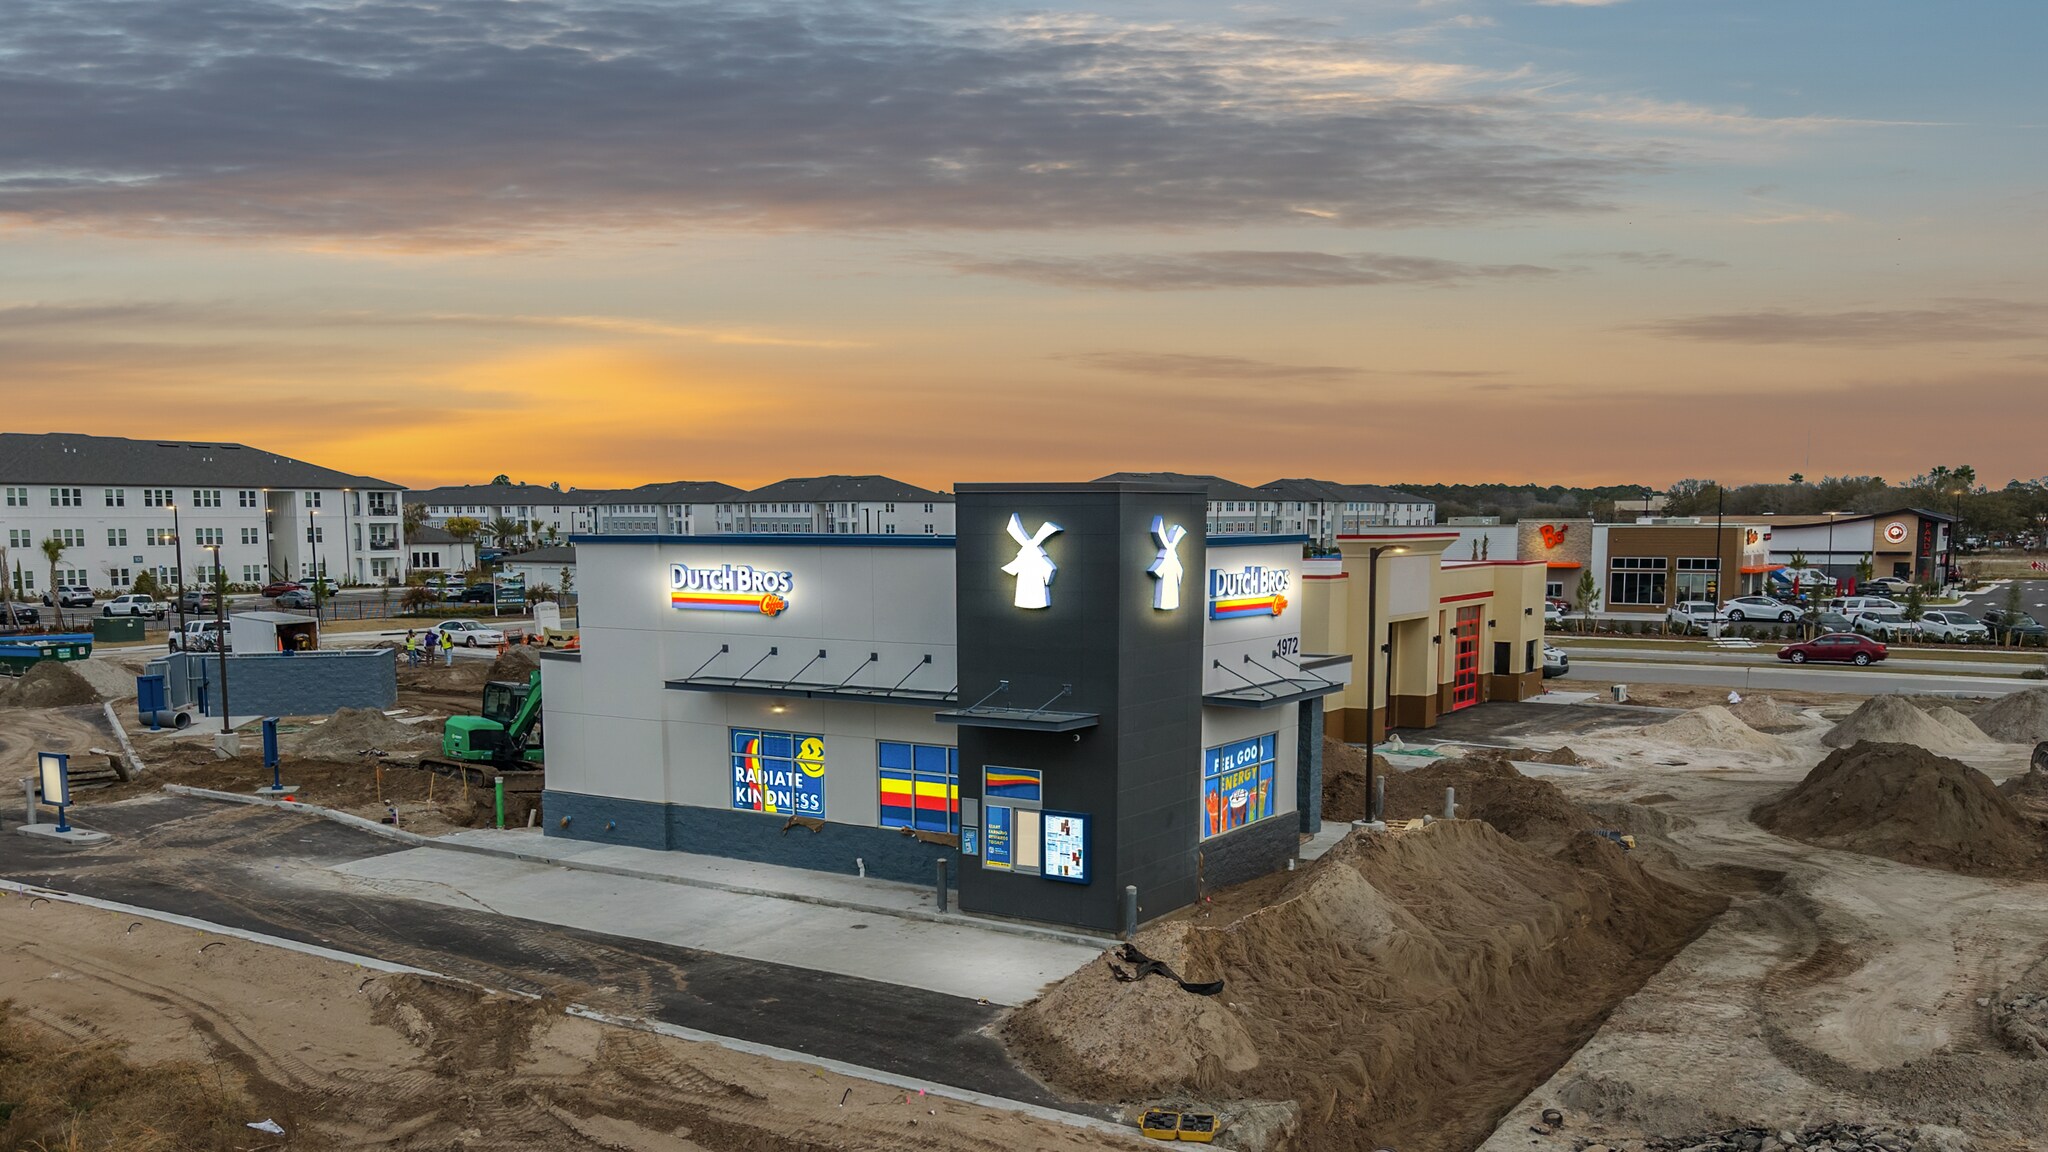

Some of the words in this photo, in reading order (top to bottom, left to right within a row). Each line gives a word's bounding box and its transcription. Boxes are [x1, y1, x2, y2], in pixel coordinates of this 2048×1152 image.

[1921, 521, 1932, 557] PANDA
[670, 564, 733, 591] DUTCH
[737, 565, 792, 592] BROS
[1215, 566, 1258, 597] DUTCH
[1260, 567, 1290, 593] BROS
[759, 593, 785, 616] Coffee
[1277, 637, 1298, 656] 1972
[735, 766, 803, 788] RADIATE
